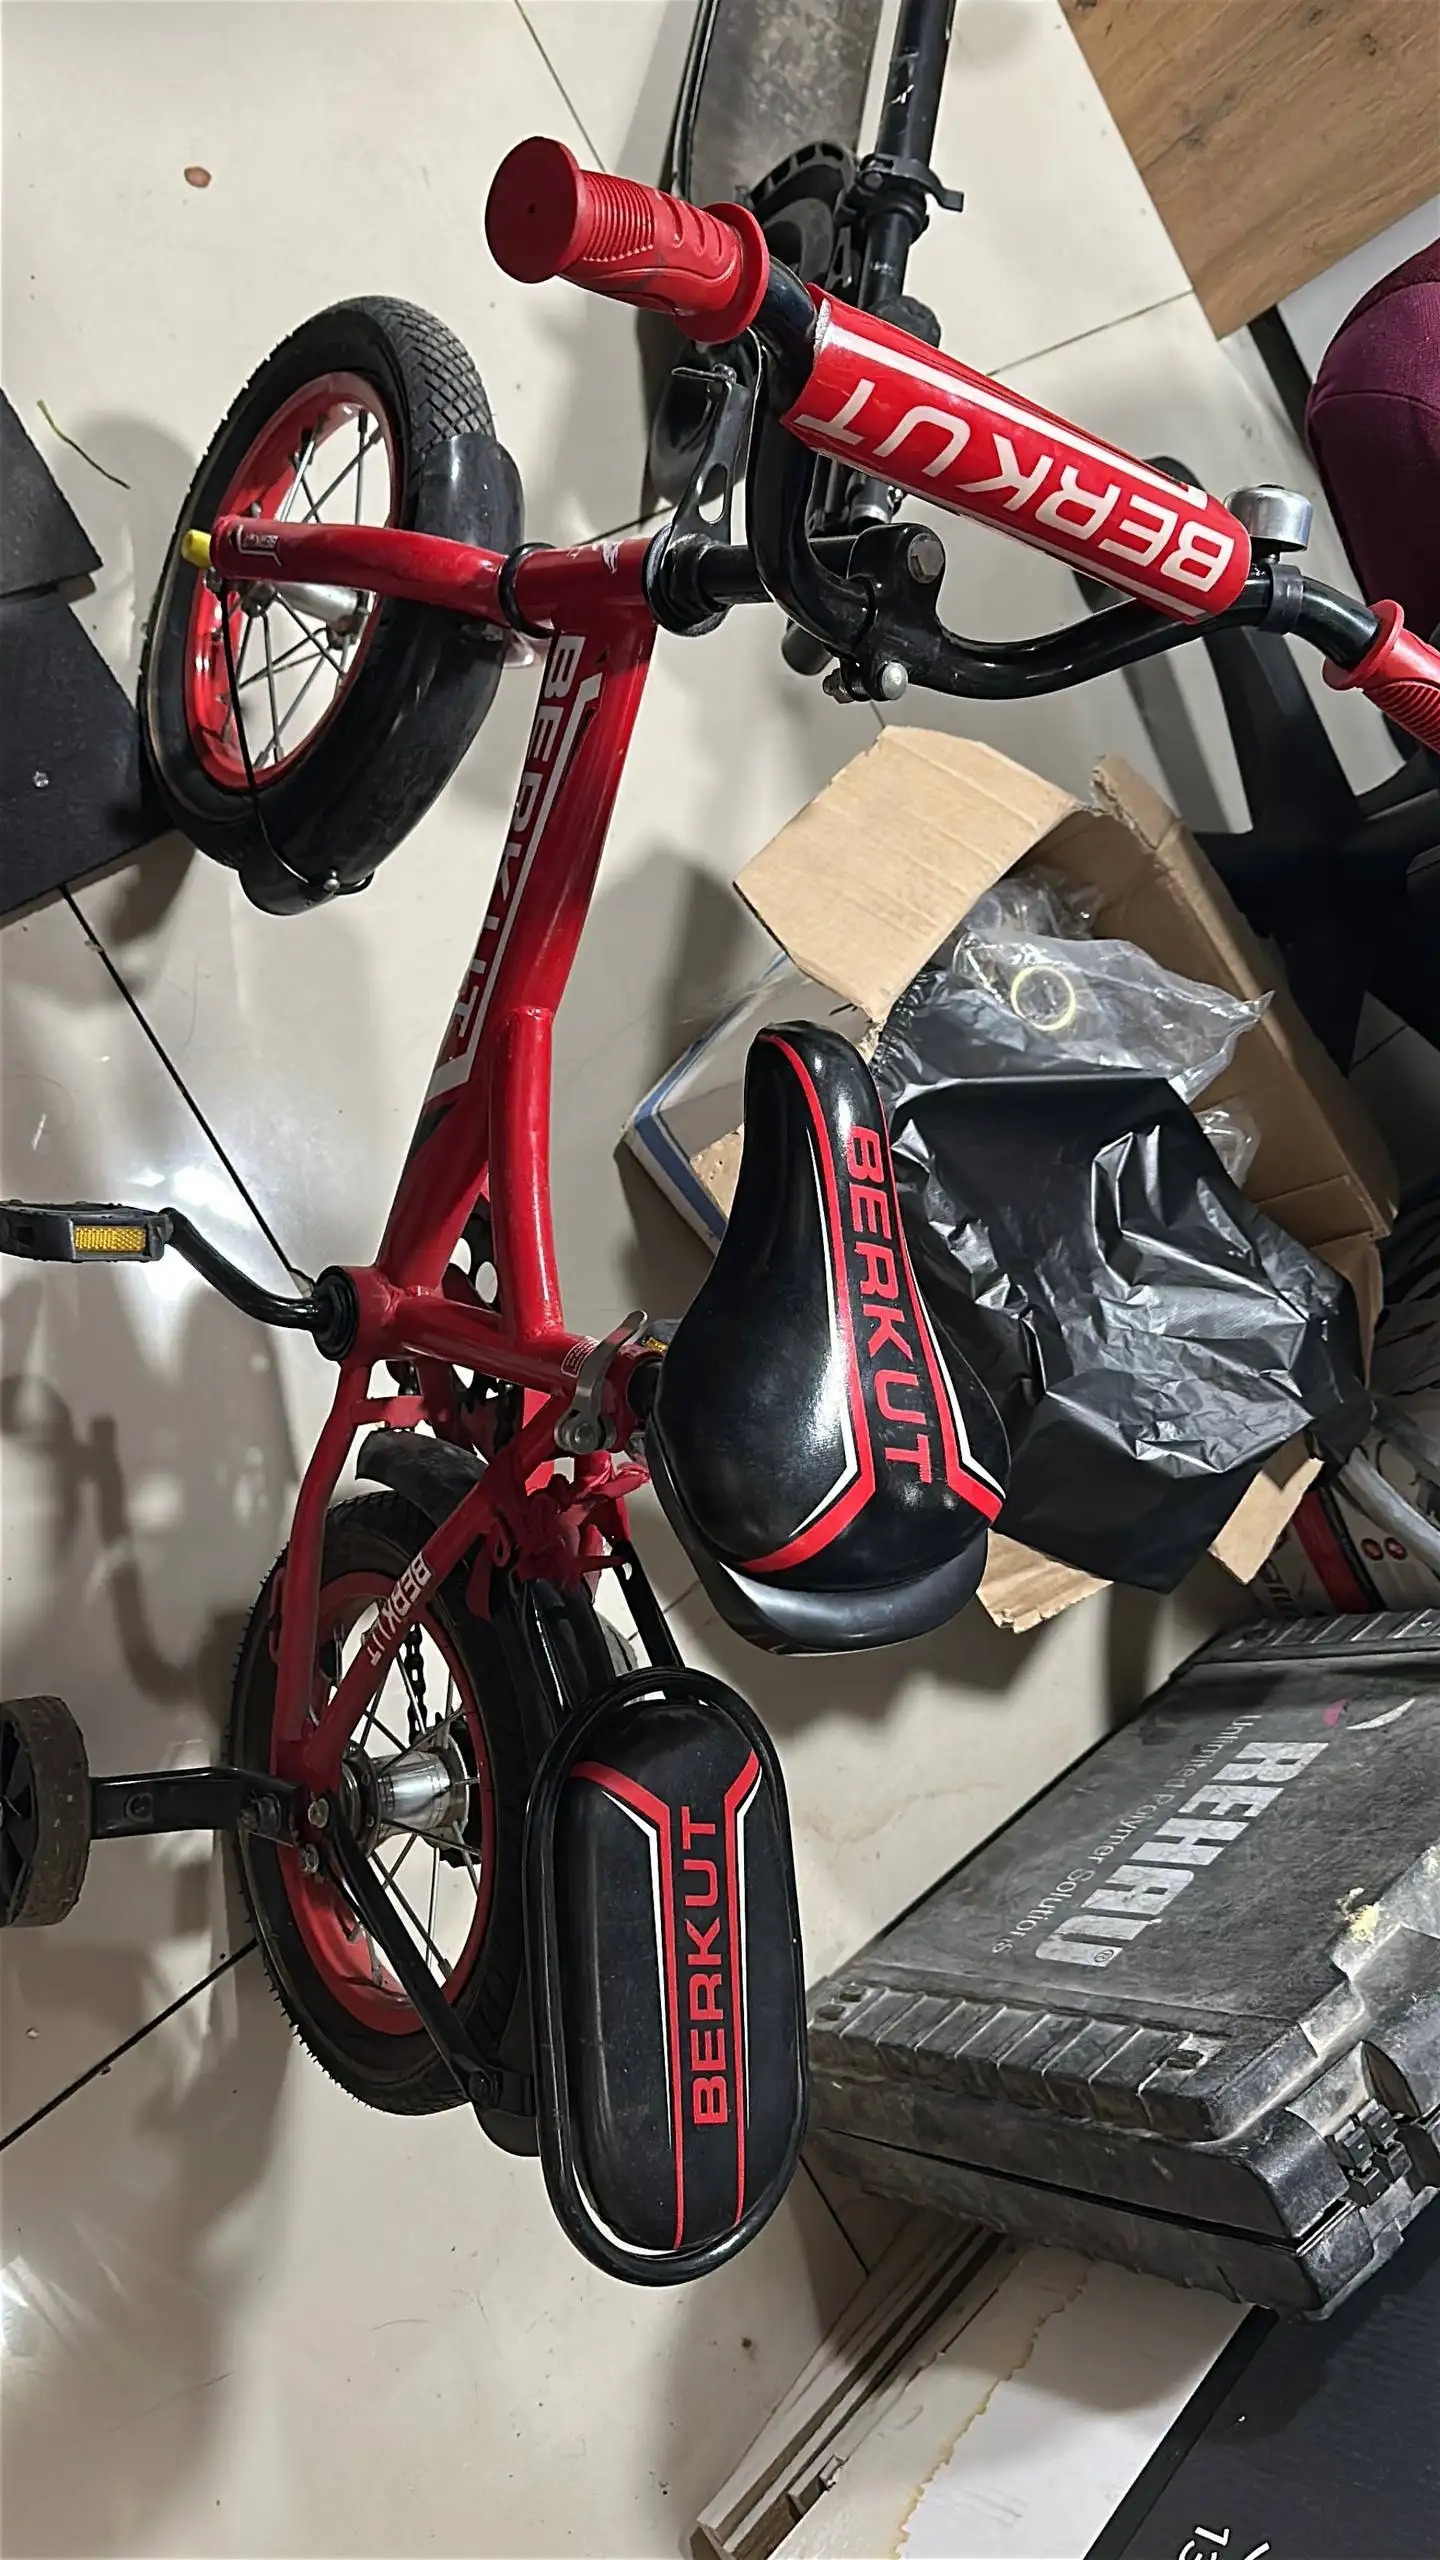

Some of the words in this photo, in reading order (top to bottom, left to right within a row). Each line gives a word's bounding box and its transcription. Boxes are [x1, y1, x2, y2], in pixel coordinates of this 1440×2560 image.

[794, 378, 1234, 592] BERKUT
[848, 1124, 932, 1484] BERKUT
[1035, 1742, 1329, 1968] REHAU
[1088, 1793, 1175, 1865] Polymer
[1161, 1714, 1262, 1788] Unlimited
[681, 1805, 729, 2125] BERKUT
